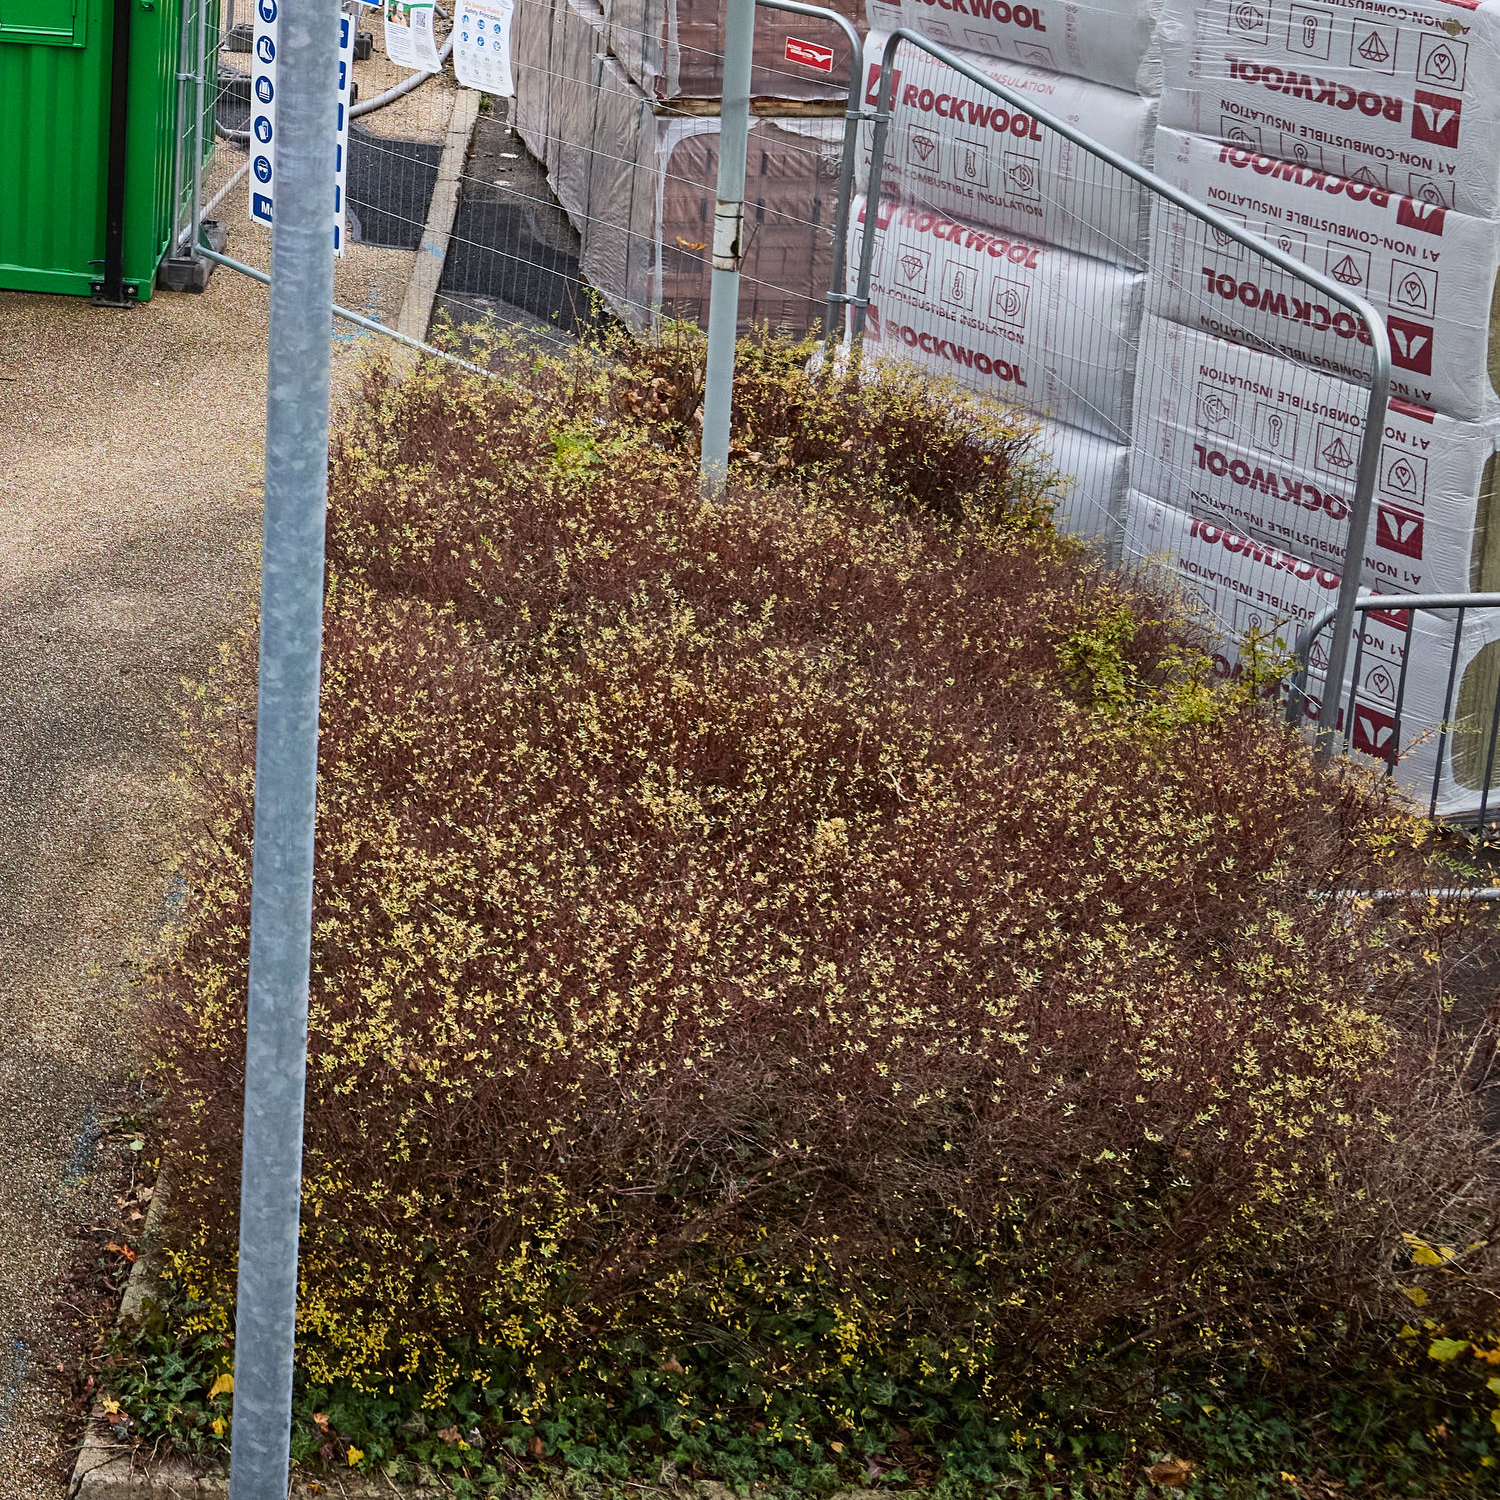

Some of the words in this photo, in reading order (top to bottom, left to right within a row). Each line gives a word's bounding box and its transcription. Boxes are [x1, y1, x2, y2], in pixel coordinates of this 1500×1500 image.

[903, 84, 1042, 142] ROCKWOOL
[1225, 53, 1403, 123] ROCKWOOL
[1220, 99, 1295, 132] INSULATION
[1299, 126, 1432, 170] NON-COMBUSTIBLE
[1438, 162, 1456, 176] A1
[1208, 186, 1282, 218] INSULATION
[1218, 145, 1391, 209] ROCKWOOL
[898, 208, 1040, 269] ROCKWOOL
[1286, 210, 1416, 256] NON-COMBUSTIBLE
[1422, 248, 1440, 262] A1
[1202, 267, 1375, 347] ROCKWOOL
[886, 319, 1027, 388] ROCKWOOL
